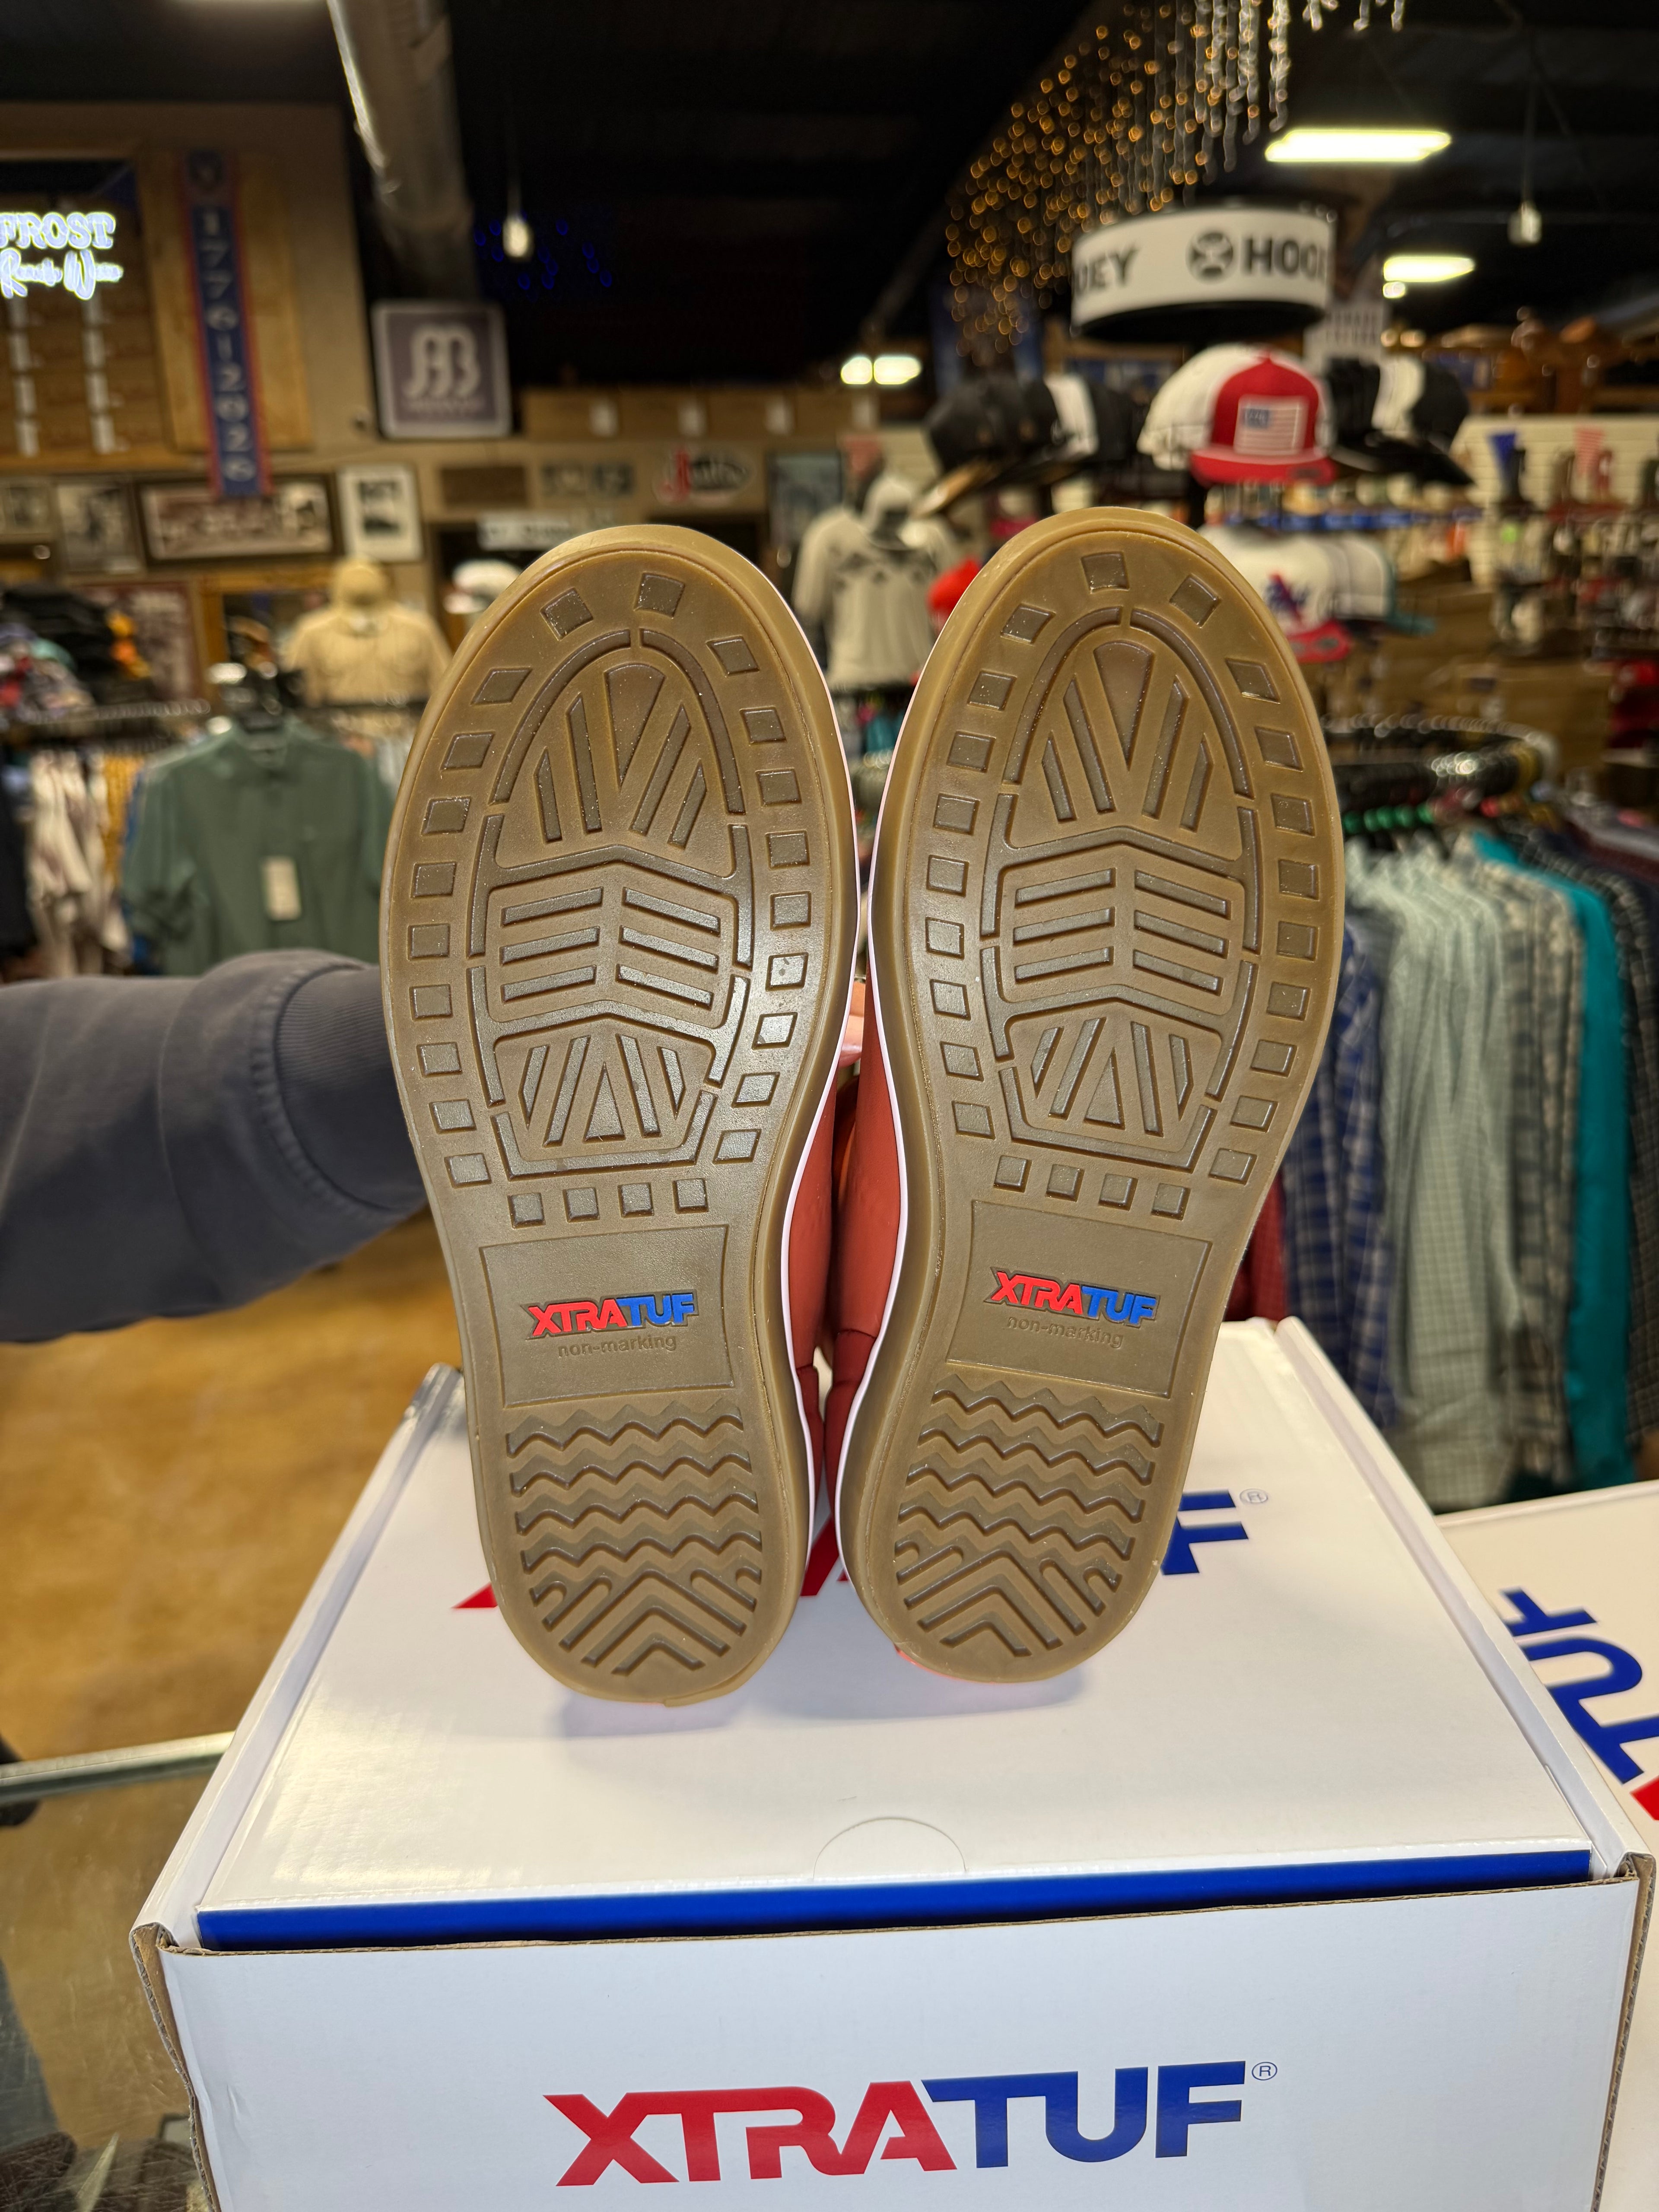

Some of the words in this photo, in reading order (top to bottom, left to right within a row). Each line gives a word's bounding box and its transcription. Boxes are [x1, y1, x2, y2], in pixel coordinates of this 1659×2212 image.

[528, 1294, 695, 1336] XTRATUF
[991, 1271, 1157, 1325] XTRATUF
[558, 1335, 677, 1357] non-marking
[1007, 1316, 1123, 1349] non-marking
[542, 2060, 1246, 2187] XTRATUF
